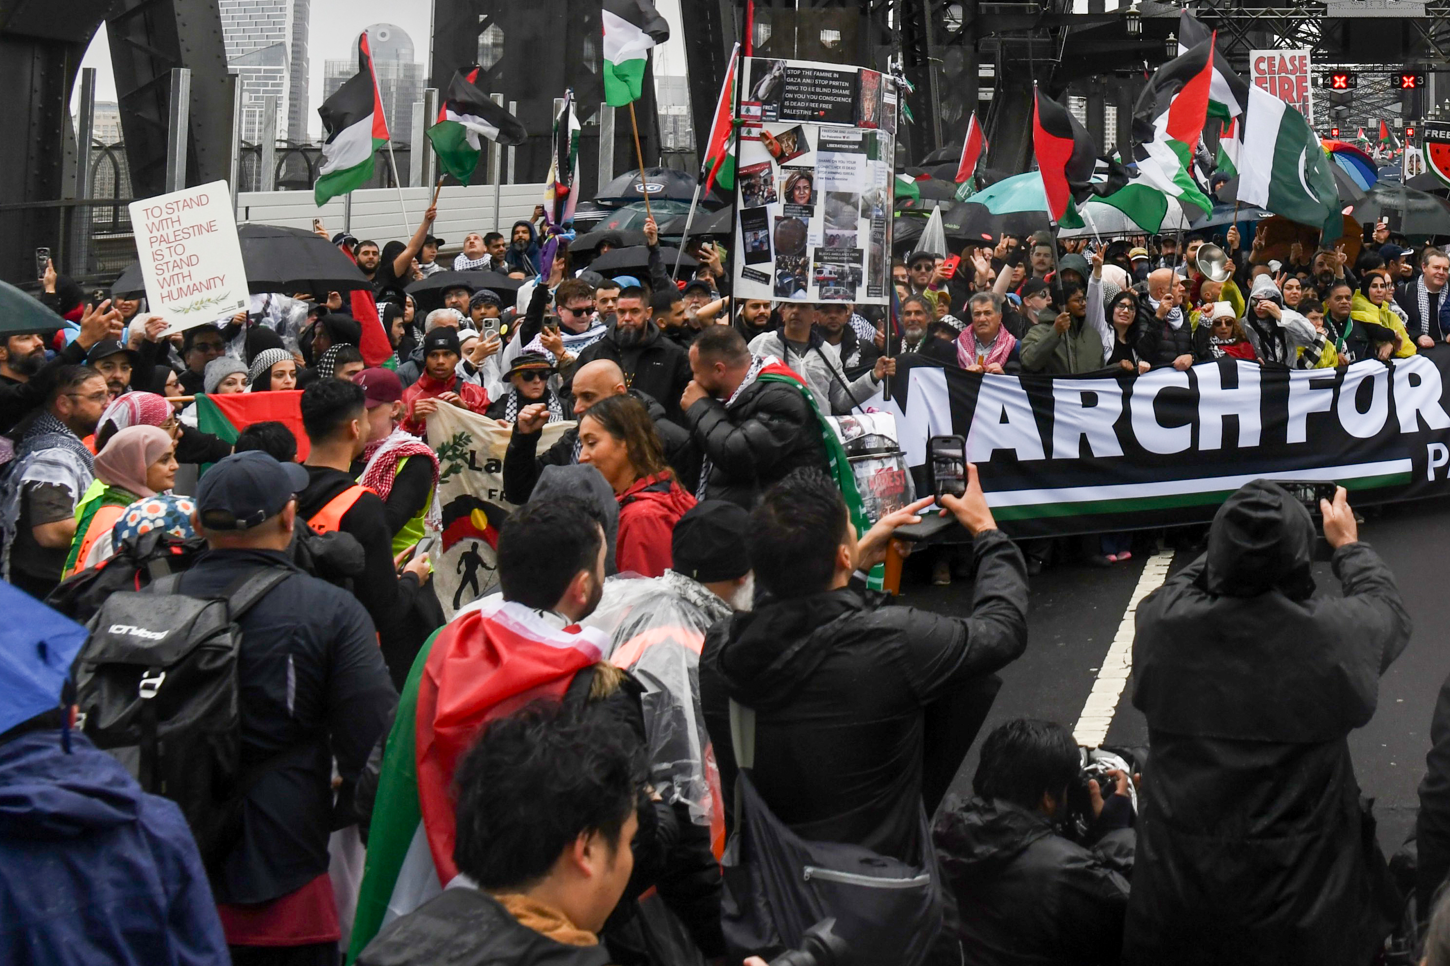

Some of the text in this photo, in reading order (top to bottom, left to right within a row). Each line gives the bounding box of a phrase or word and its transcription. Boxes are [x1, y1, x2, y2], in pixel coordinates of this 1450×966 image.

[1254, 55, 1307, 75] CEASE
[1255, 75, 1309, 103] FIRE
[1323, 76, 1355, 84] 4 4
[1393, 76, 1424, 84] 3 3
[819, 95, 852, 103] CONSCIENCE
[143, 194, 209, 221] TO STAND
[145, 215, 182, 234] WITH
[149, 219, 219, 248] PALESTINE
[152, 243, 186, 262] IS TO
[155, 253, 200, 276] STAND
[157, 270, 192, 290] WITH
[160, 274, 227, 304] HUMANITY
[852, 358, 1262, 468] MARCH
